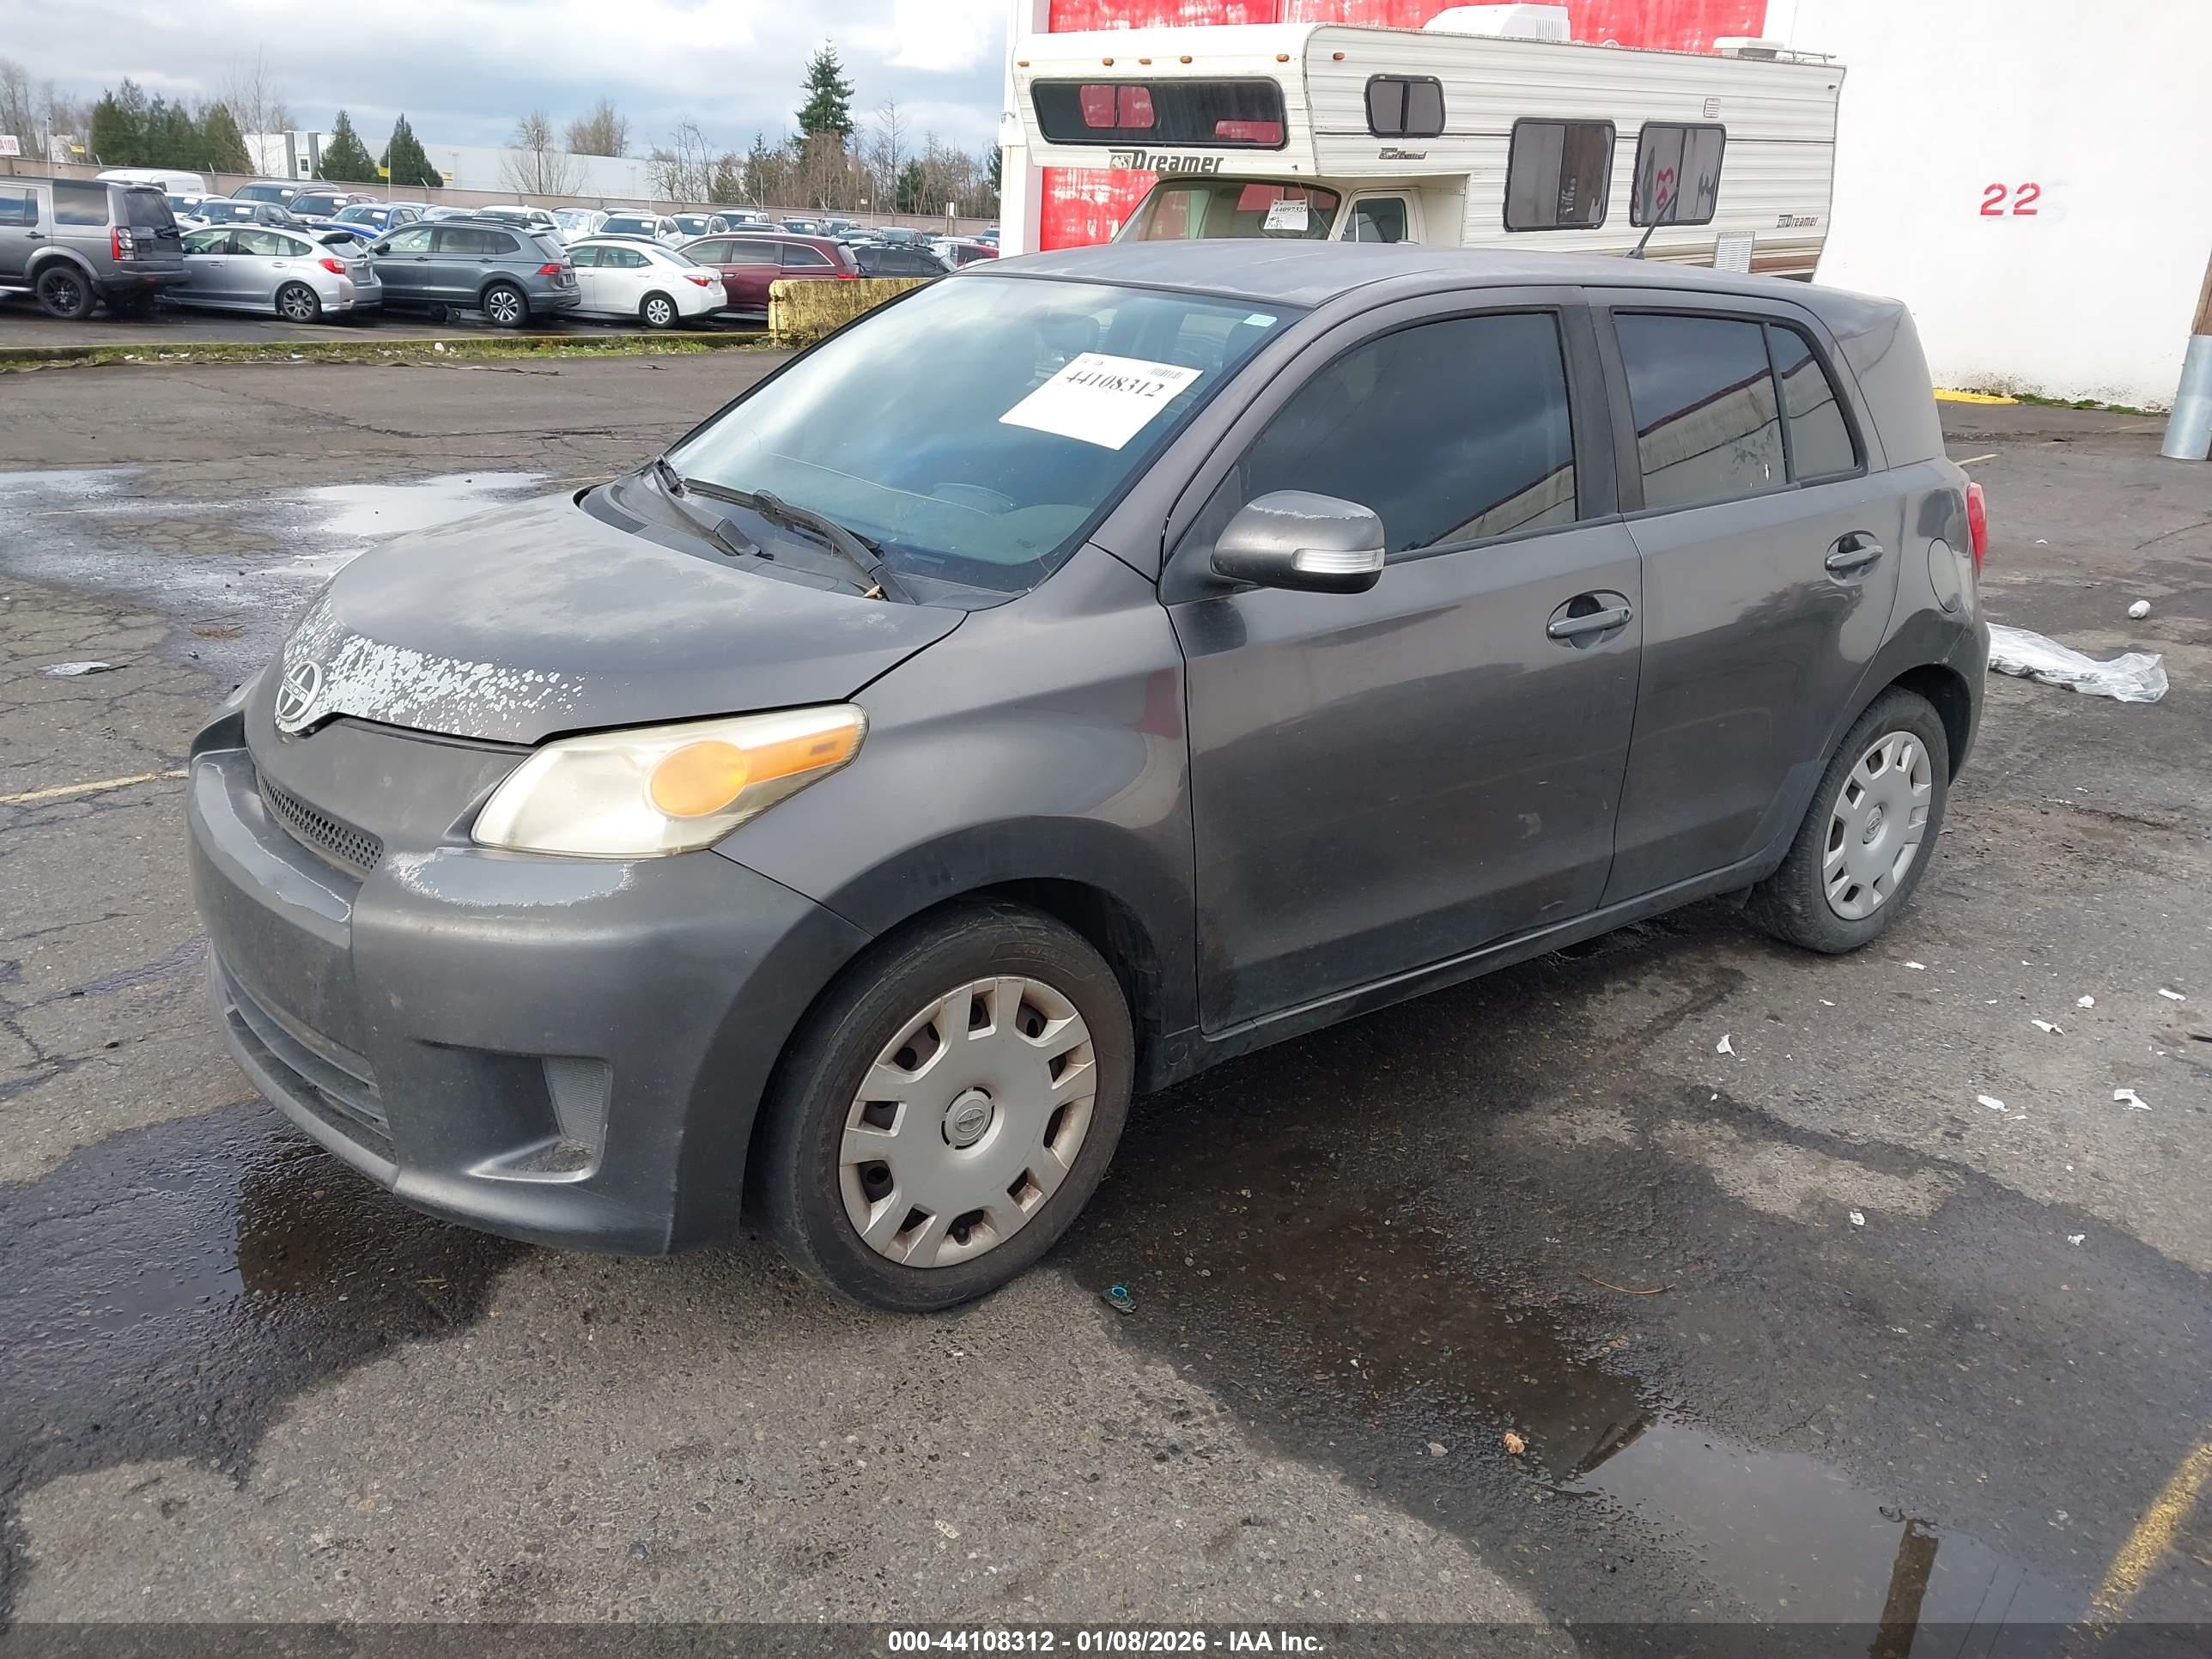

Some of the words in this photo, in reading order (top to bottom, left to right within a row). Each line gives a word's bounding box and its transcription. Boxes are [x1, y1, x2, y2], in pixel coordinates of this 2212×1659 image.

[1109, 149, 1224, 173] Dreamer
[1980, 183, 2040, 216] 22
[1779, 214, 1819, 228] Dreamer
[1066, 370, 1165, 398] 44108312
